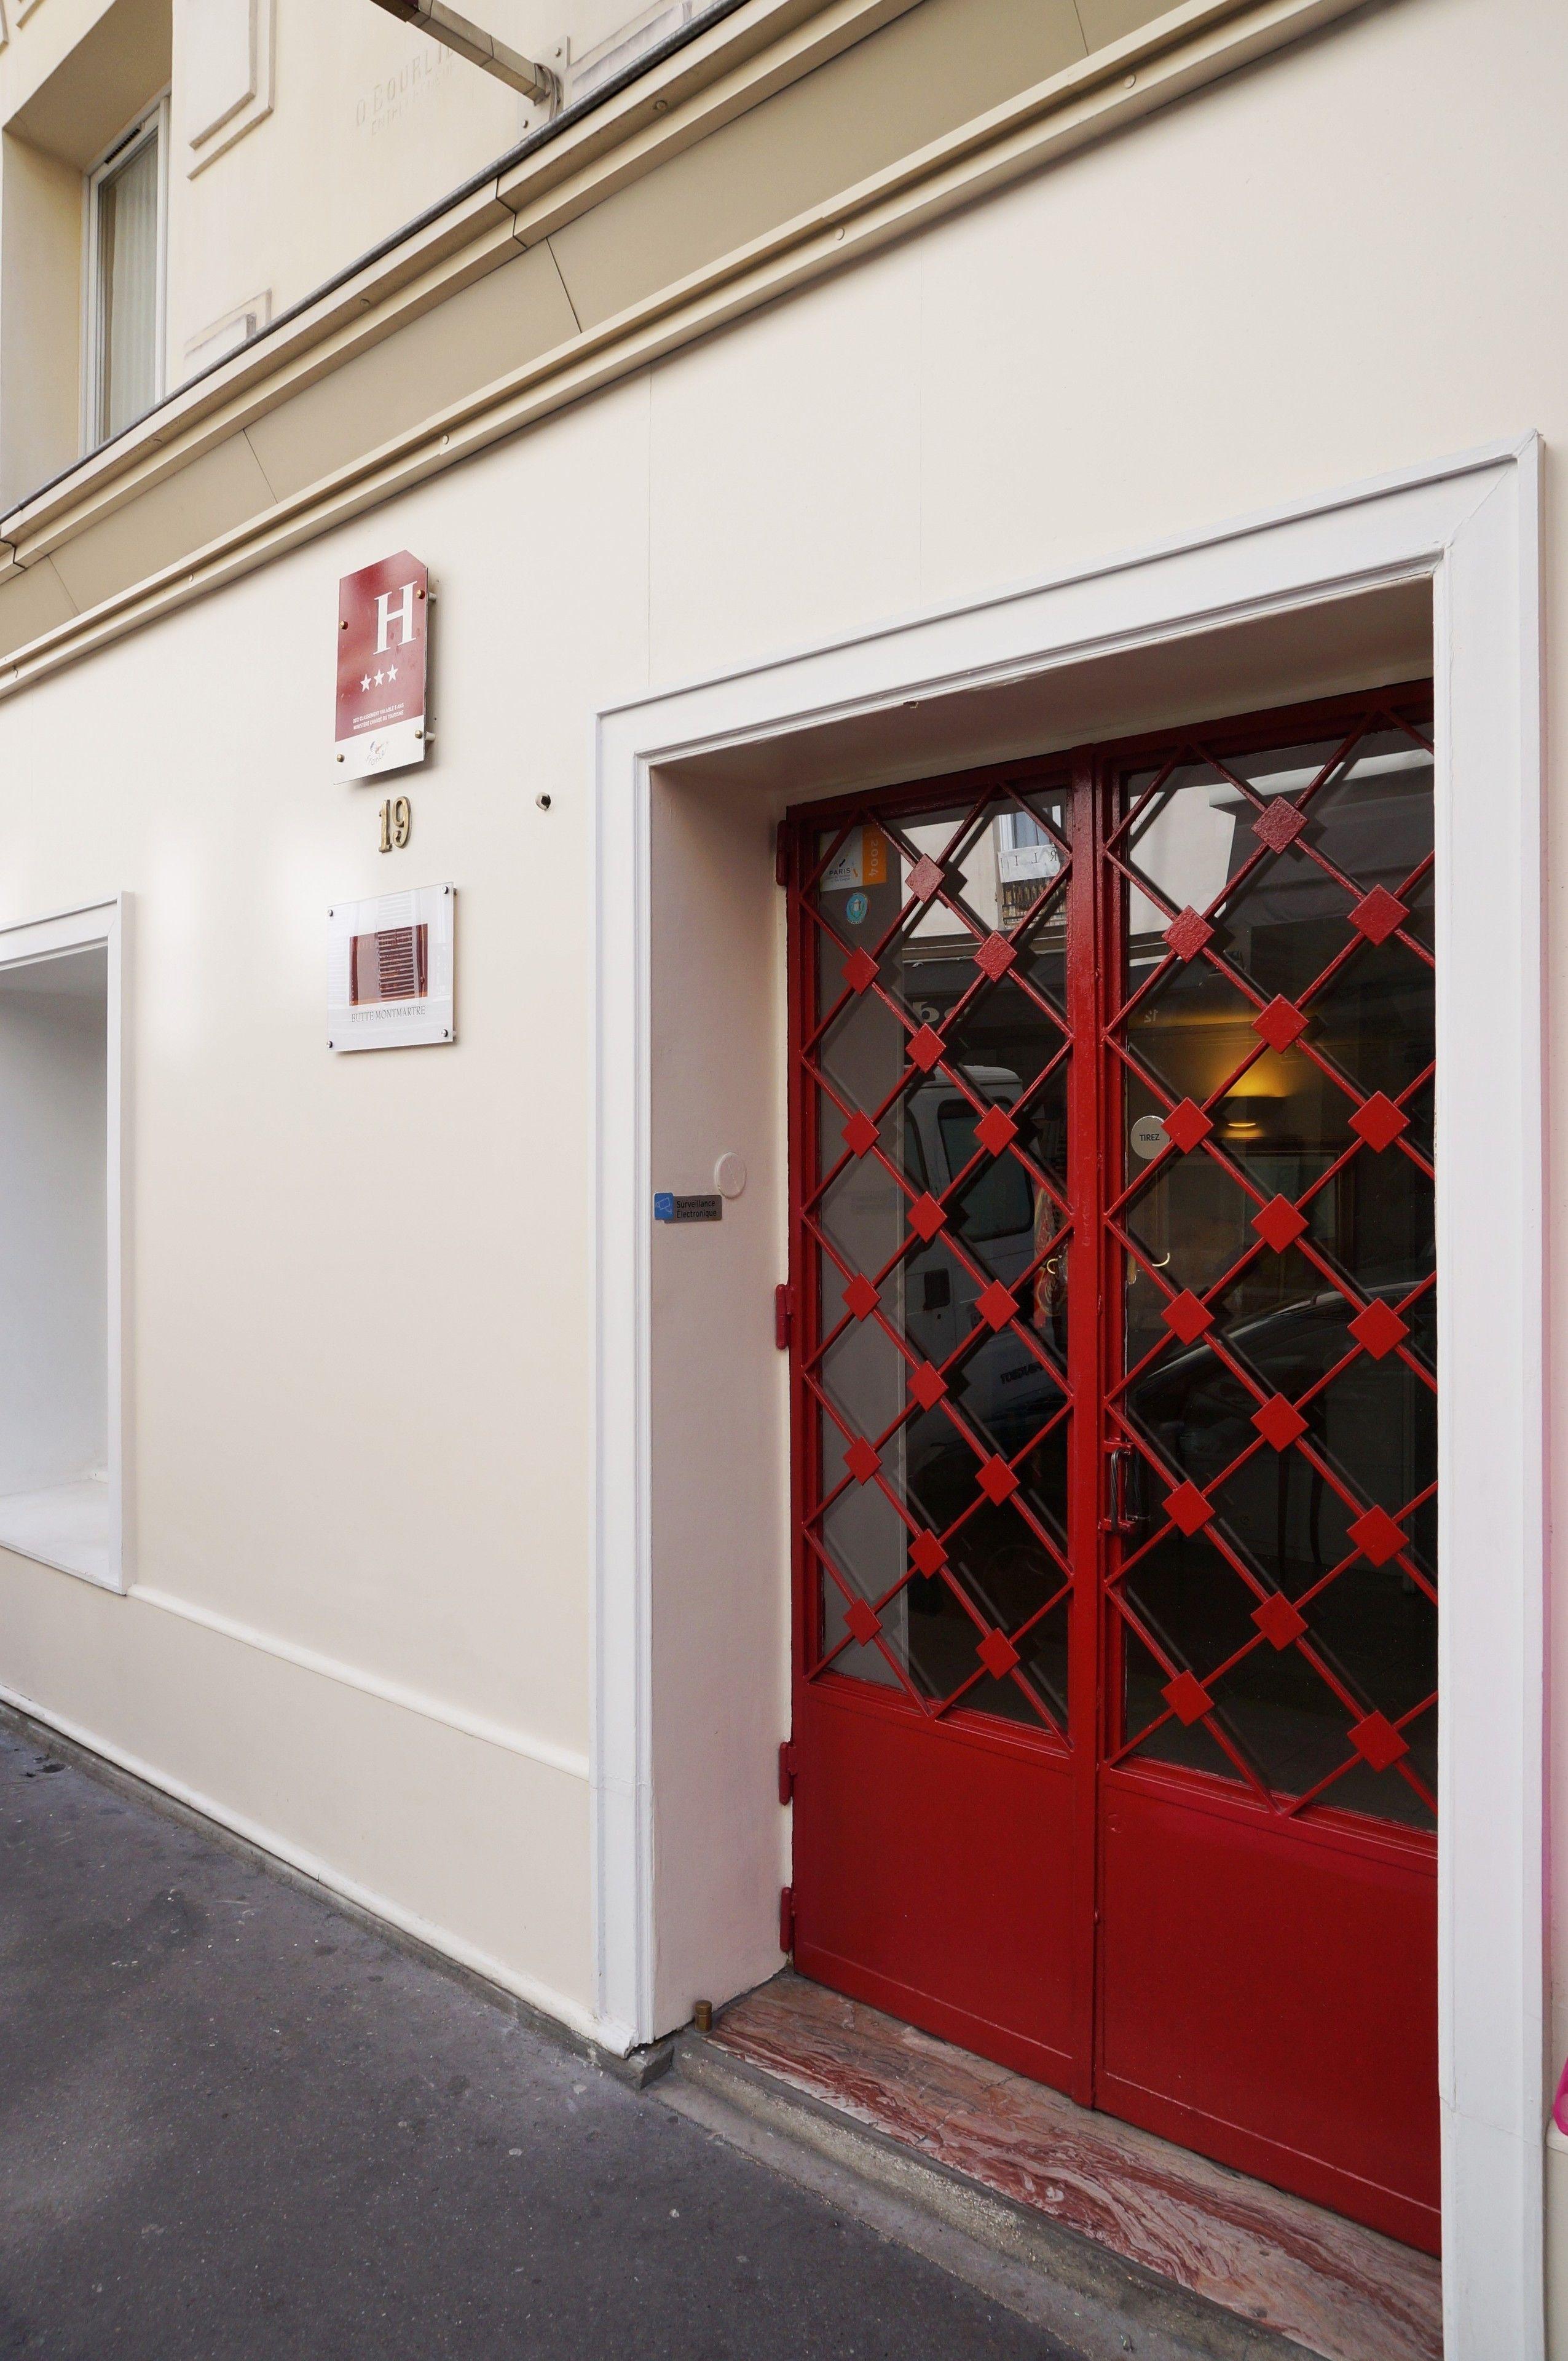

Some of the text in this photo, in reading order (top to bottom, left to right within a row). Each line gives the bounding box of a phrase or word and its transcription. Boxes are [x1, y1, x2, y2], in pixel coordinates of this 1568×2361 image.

[372, 580, 418, 655] H
[360, 711, 379, 721] CLASSEMENT
[379, 705, 394, 715] VALABLE
[388, 710, 404, 719] TOURISME
[379, 796, 411, 853] 19
[869, 838, 879, 877] 2004
[351, 1005, 425, 1022] BUTTE MONTMARTRE
[676, 1209, 717, 1218] Électronique
